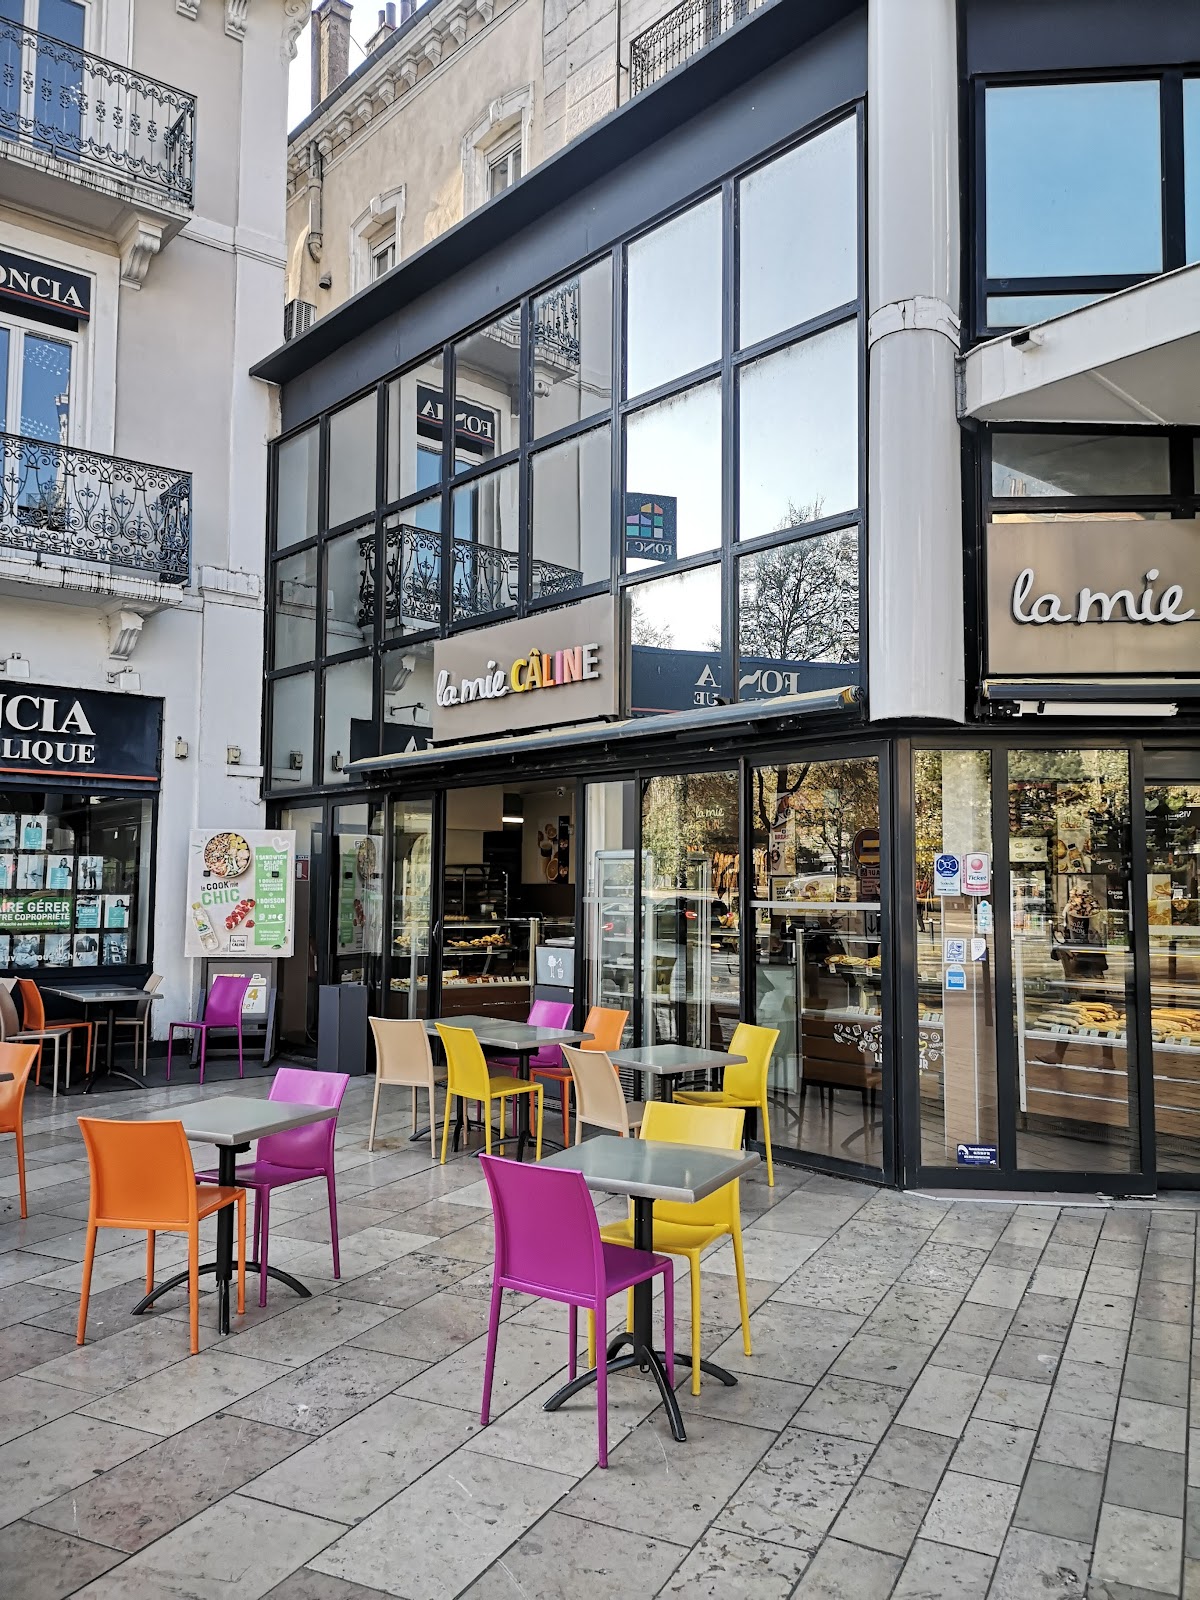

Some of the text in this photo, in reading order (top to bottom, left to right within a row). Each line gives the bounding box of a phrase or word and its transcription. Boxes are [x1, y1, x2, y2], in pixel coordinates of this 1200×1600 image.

[1012, 568, 1196, 623] la mie
[436, 643, 600, 707] la mie CÂLINE
[201, 889, 240, 905] CHIC
[27, 899, 70, 913] GÉRER
[14, 911, 70, 920] COPROPRIÉTÉ
